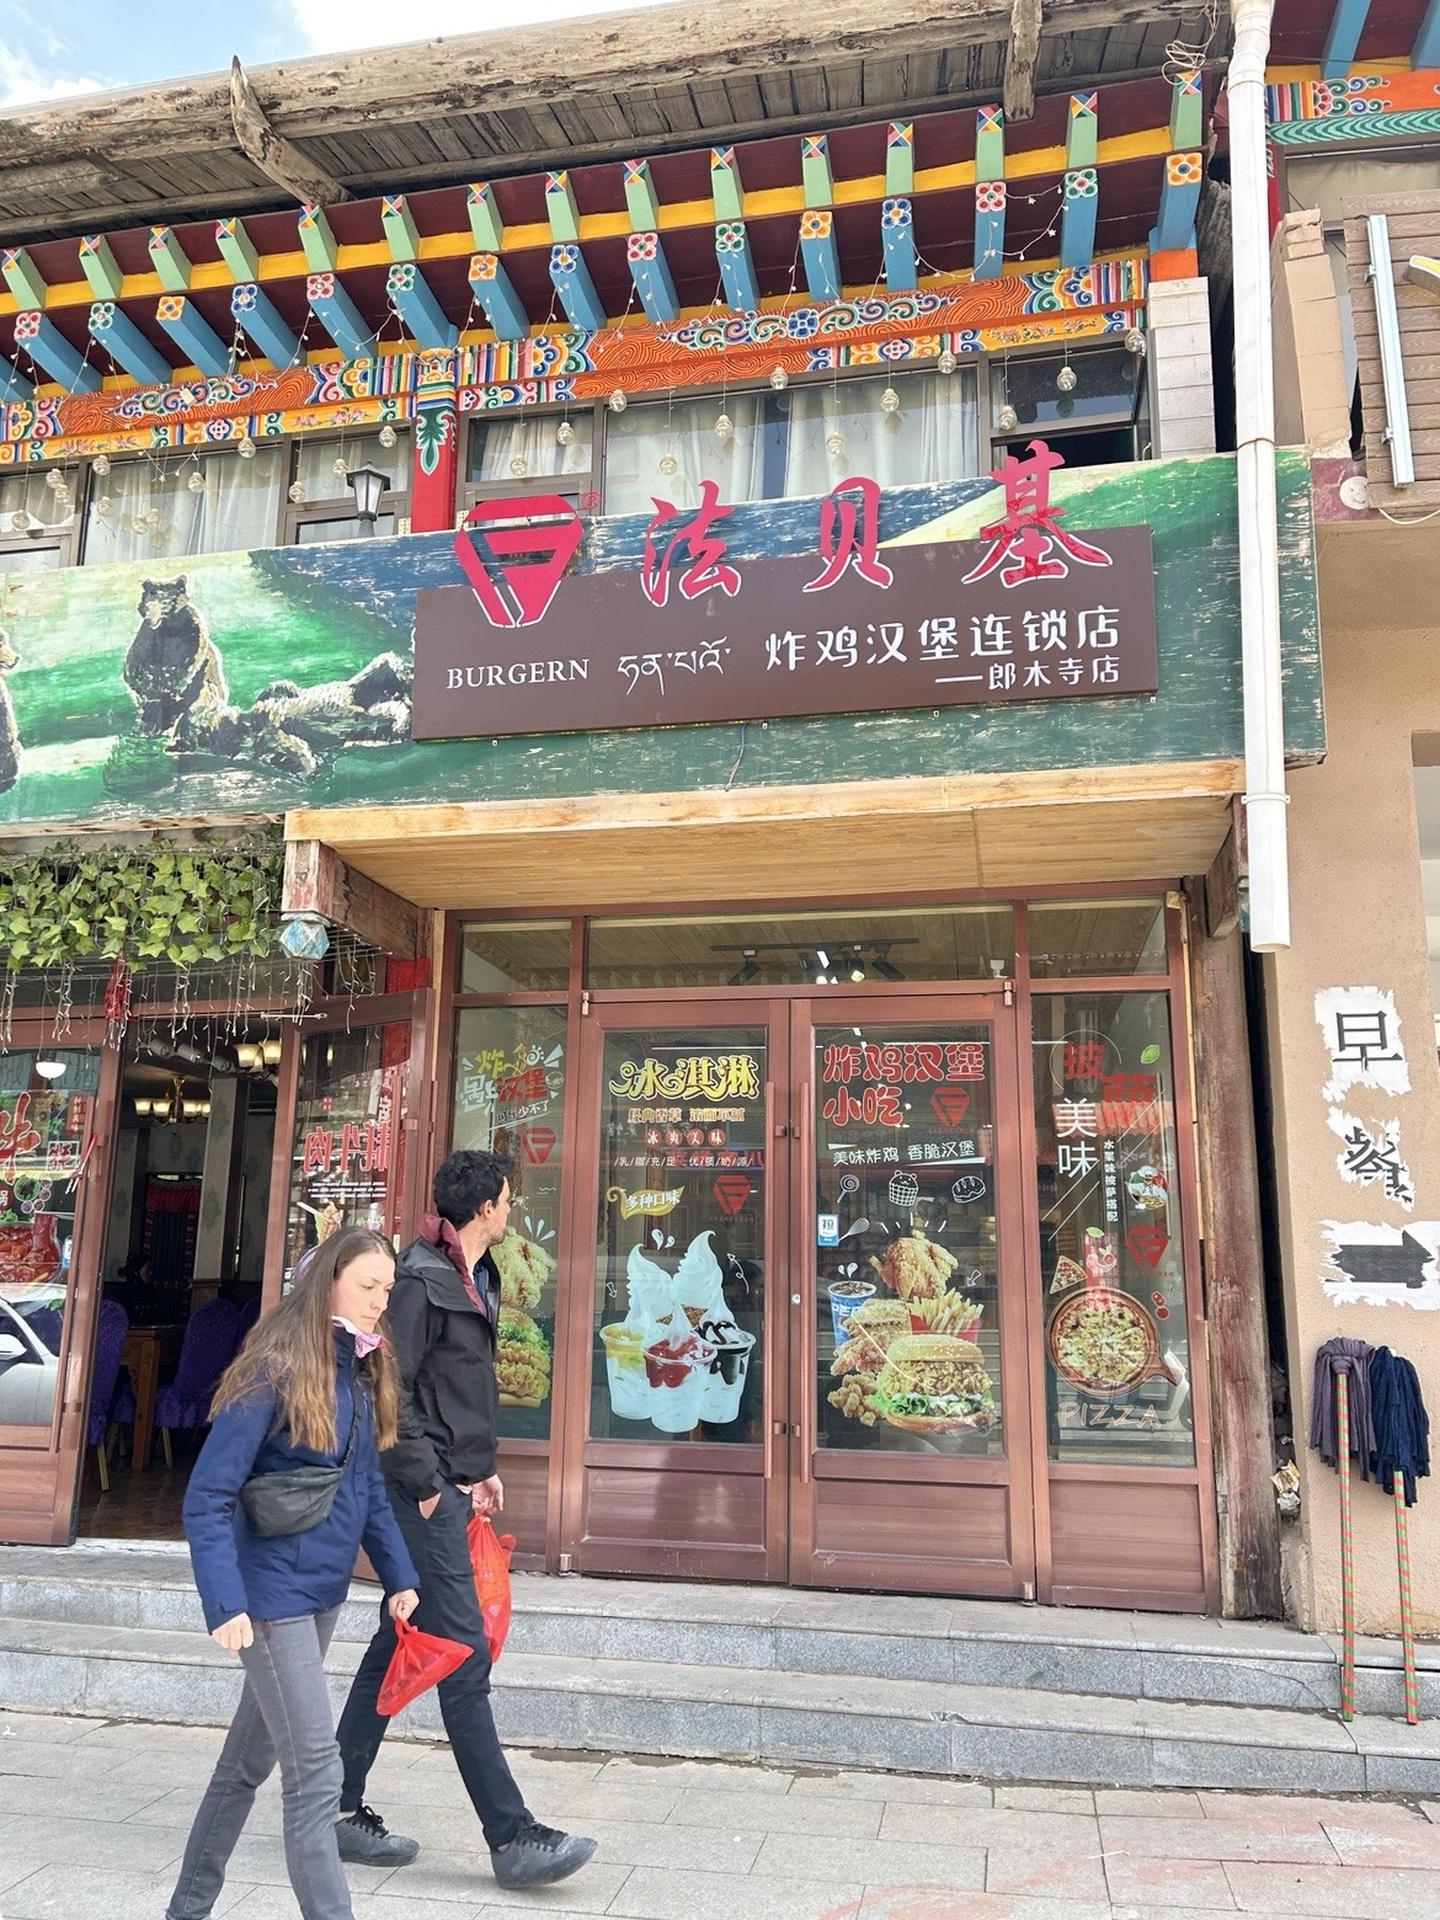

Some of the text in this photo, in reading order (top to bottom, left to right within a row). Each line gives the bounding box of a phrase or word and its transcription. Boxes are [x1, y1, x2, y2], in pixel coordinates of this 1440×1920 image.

[640, 438, 1113, 607] 法贝基
[765, 605, 1120, 671] 炸鸡汉堡连锁店
[446, 659, 590, 689] BURGERN
[608, 1055, 760, 1102] 冰淇淋
[822, 1042, 985, 1083] 炸鸡汉堡
[822, 1085, 904, 1127] 小吃
[832, 1140, 976, 1168] 美味炸鸡 香脆汉堡
[1056, 1097, 1098, 1178] 美味
[626, 1189, 682, 1209] 多种口味
[1058, 1401, 1161, 1428] PIZZA
